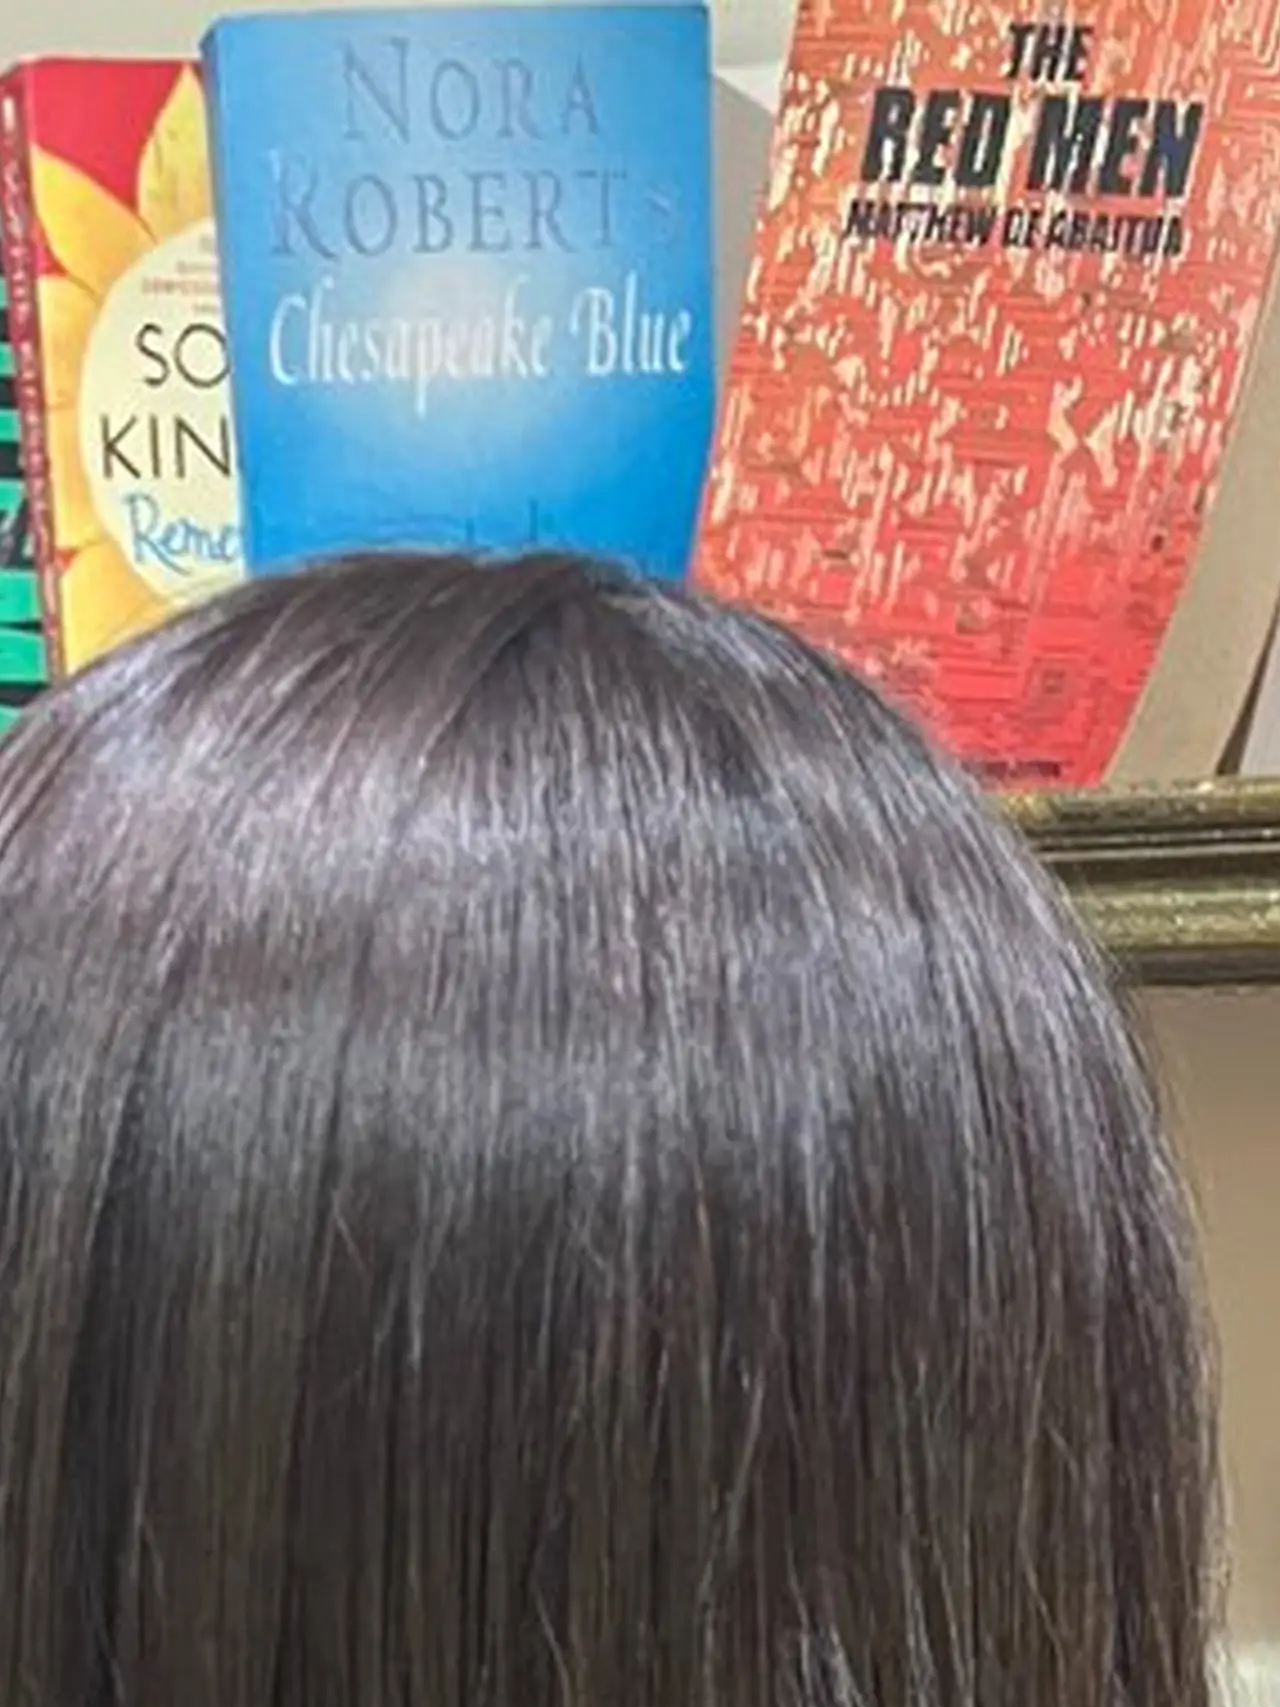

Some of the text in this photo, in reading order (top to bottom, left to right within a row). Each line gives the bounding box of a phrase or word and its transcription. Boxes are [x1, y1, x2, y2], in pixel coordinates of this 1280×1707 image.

[1004, 22, 1094, 81] THE
[340, 35, 601, 143] NORA
[861, 87, 1204, 197] RED MEN
[845, 198, 999, 247] MATTHEW
[135, 322, 229, 389] SO
[269, 271, 692, 416] Chesapeake Blue
[98, 413, 232, 479] KIN
